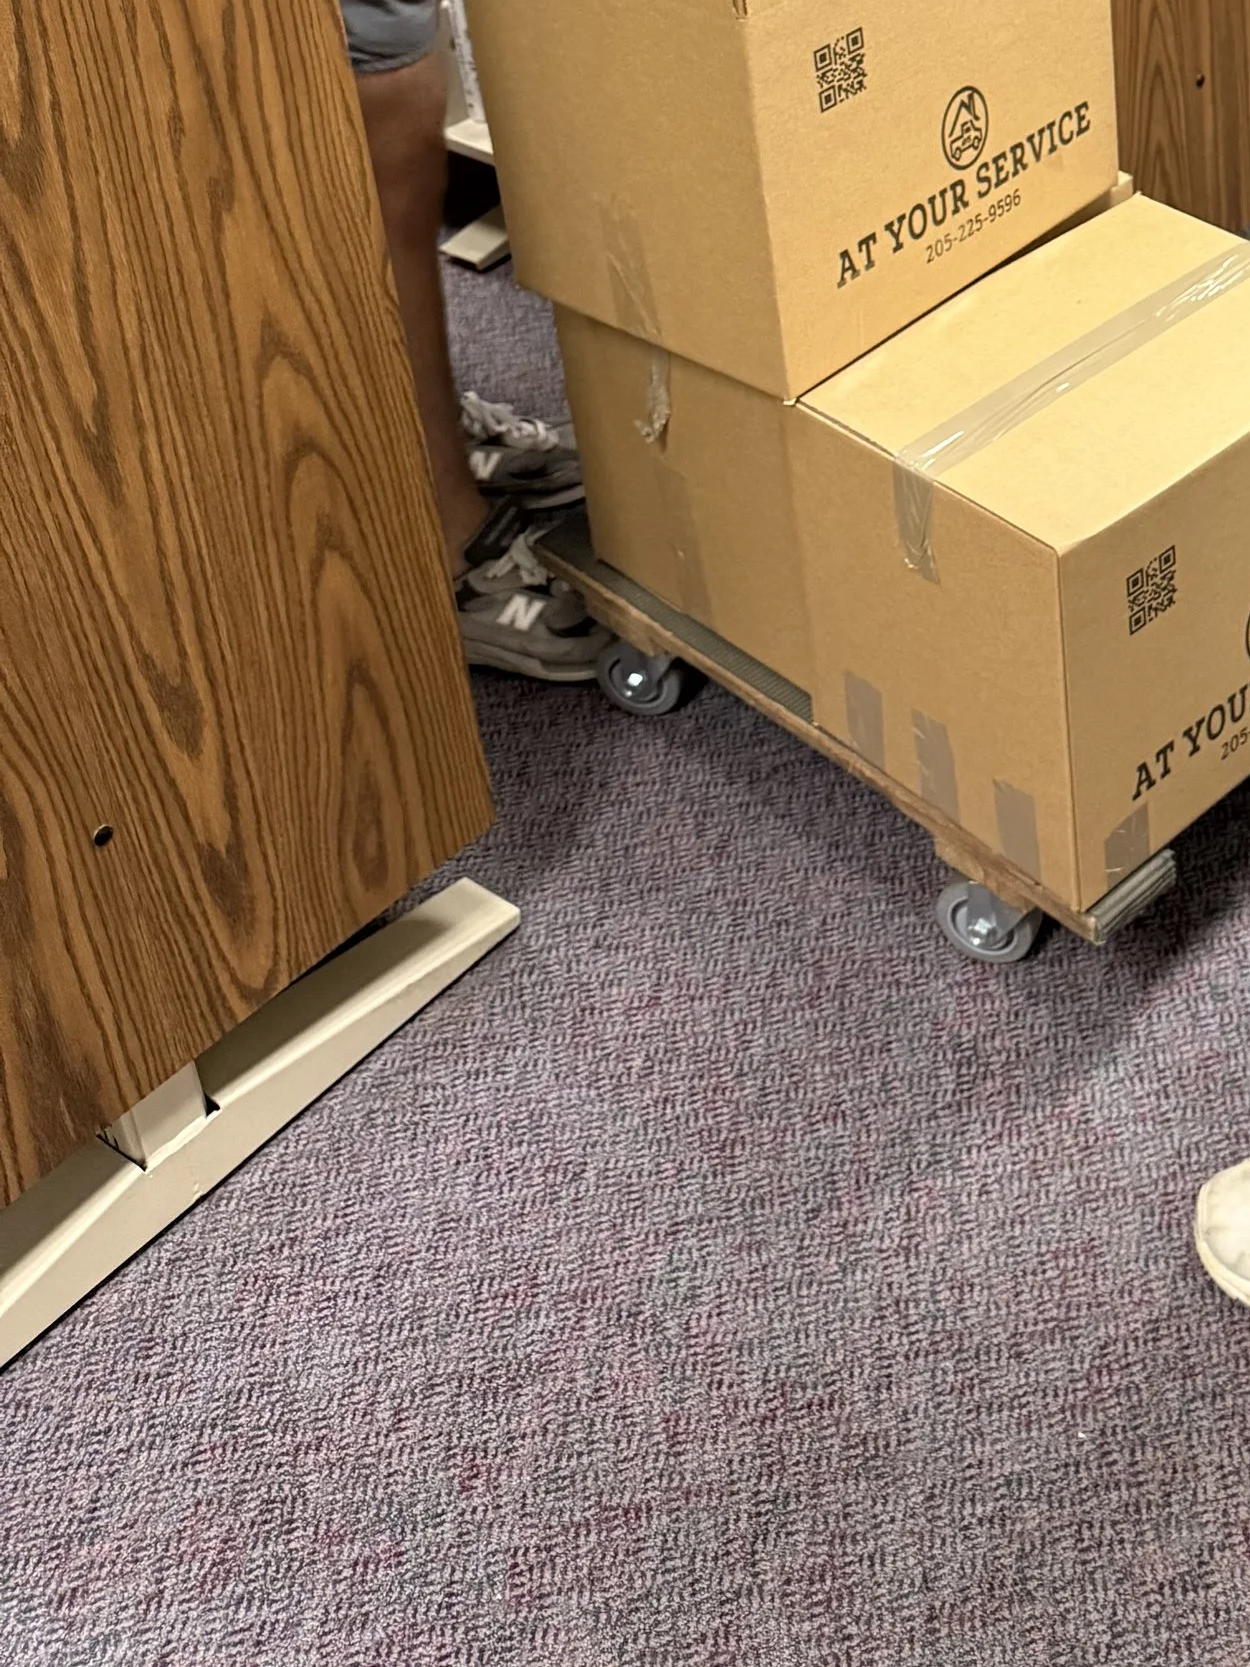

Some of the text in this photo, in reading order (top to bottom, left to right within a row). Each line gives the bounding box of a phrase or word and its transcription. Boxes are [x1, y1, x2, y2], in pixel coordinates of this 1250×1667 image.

[837, 101, 1091, 289] AT YOUR SERVICE
[926, 188, 1022, 263] 205-225-9596
[497, 595, 547, 631] N
[1132, 741, 1175, 800] AT
